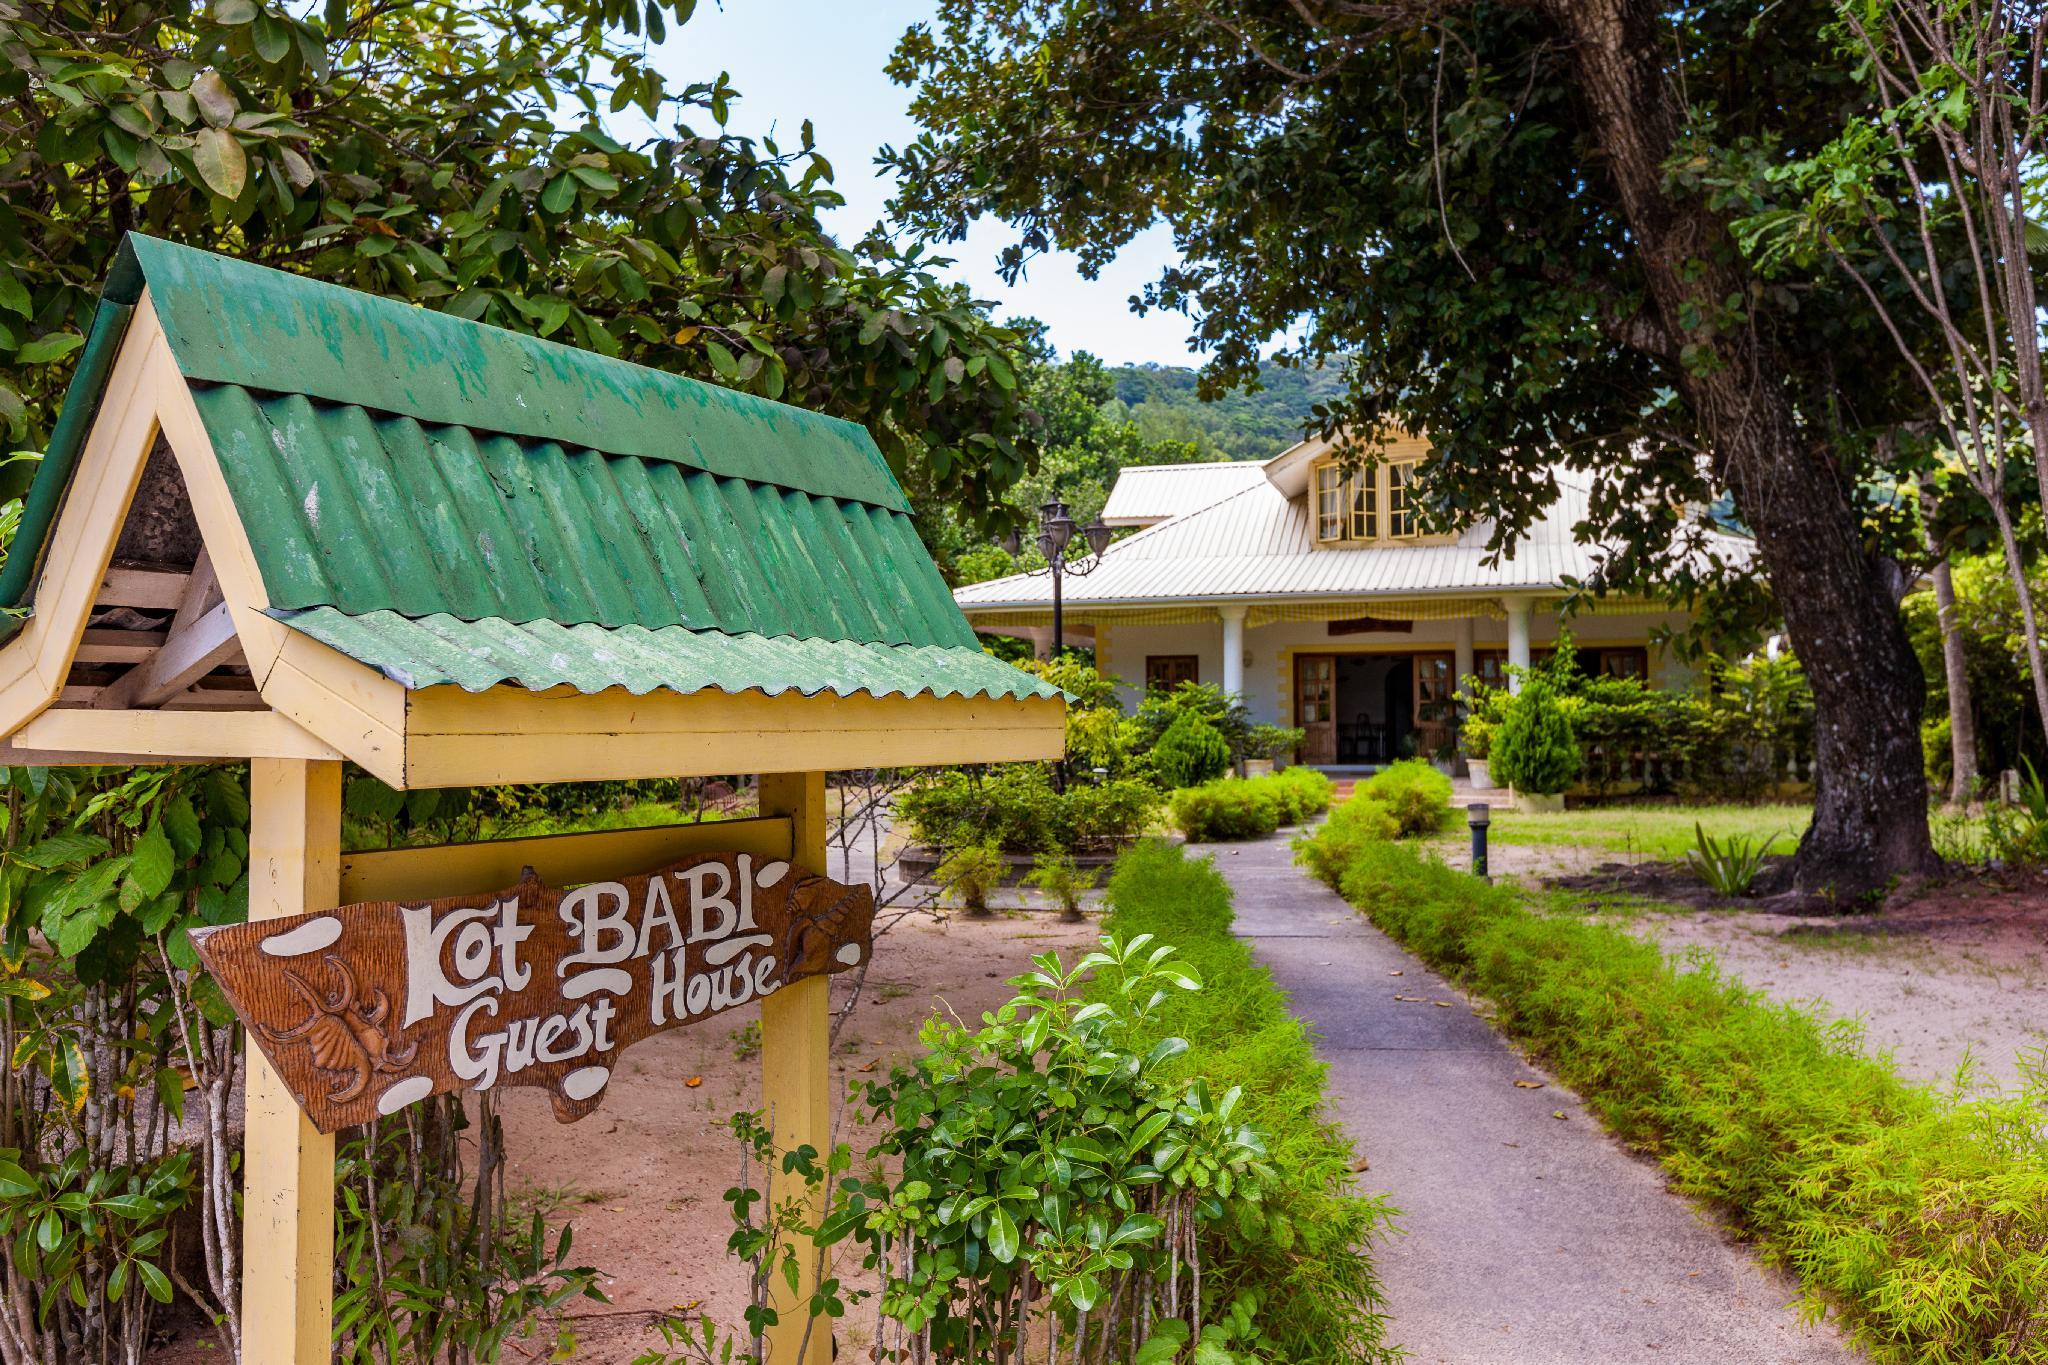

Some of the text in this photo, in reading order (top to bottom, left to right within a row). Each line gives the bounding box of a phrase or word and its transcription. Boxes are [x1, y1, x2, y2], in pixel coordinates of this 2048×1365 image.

[402, 853, 757, 1030] Kot BABI
[448, 943, 782, 1092] Guest House
